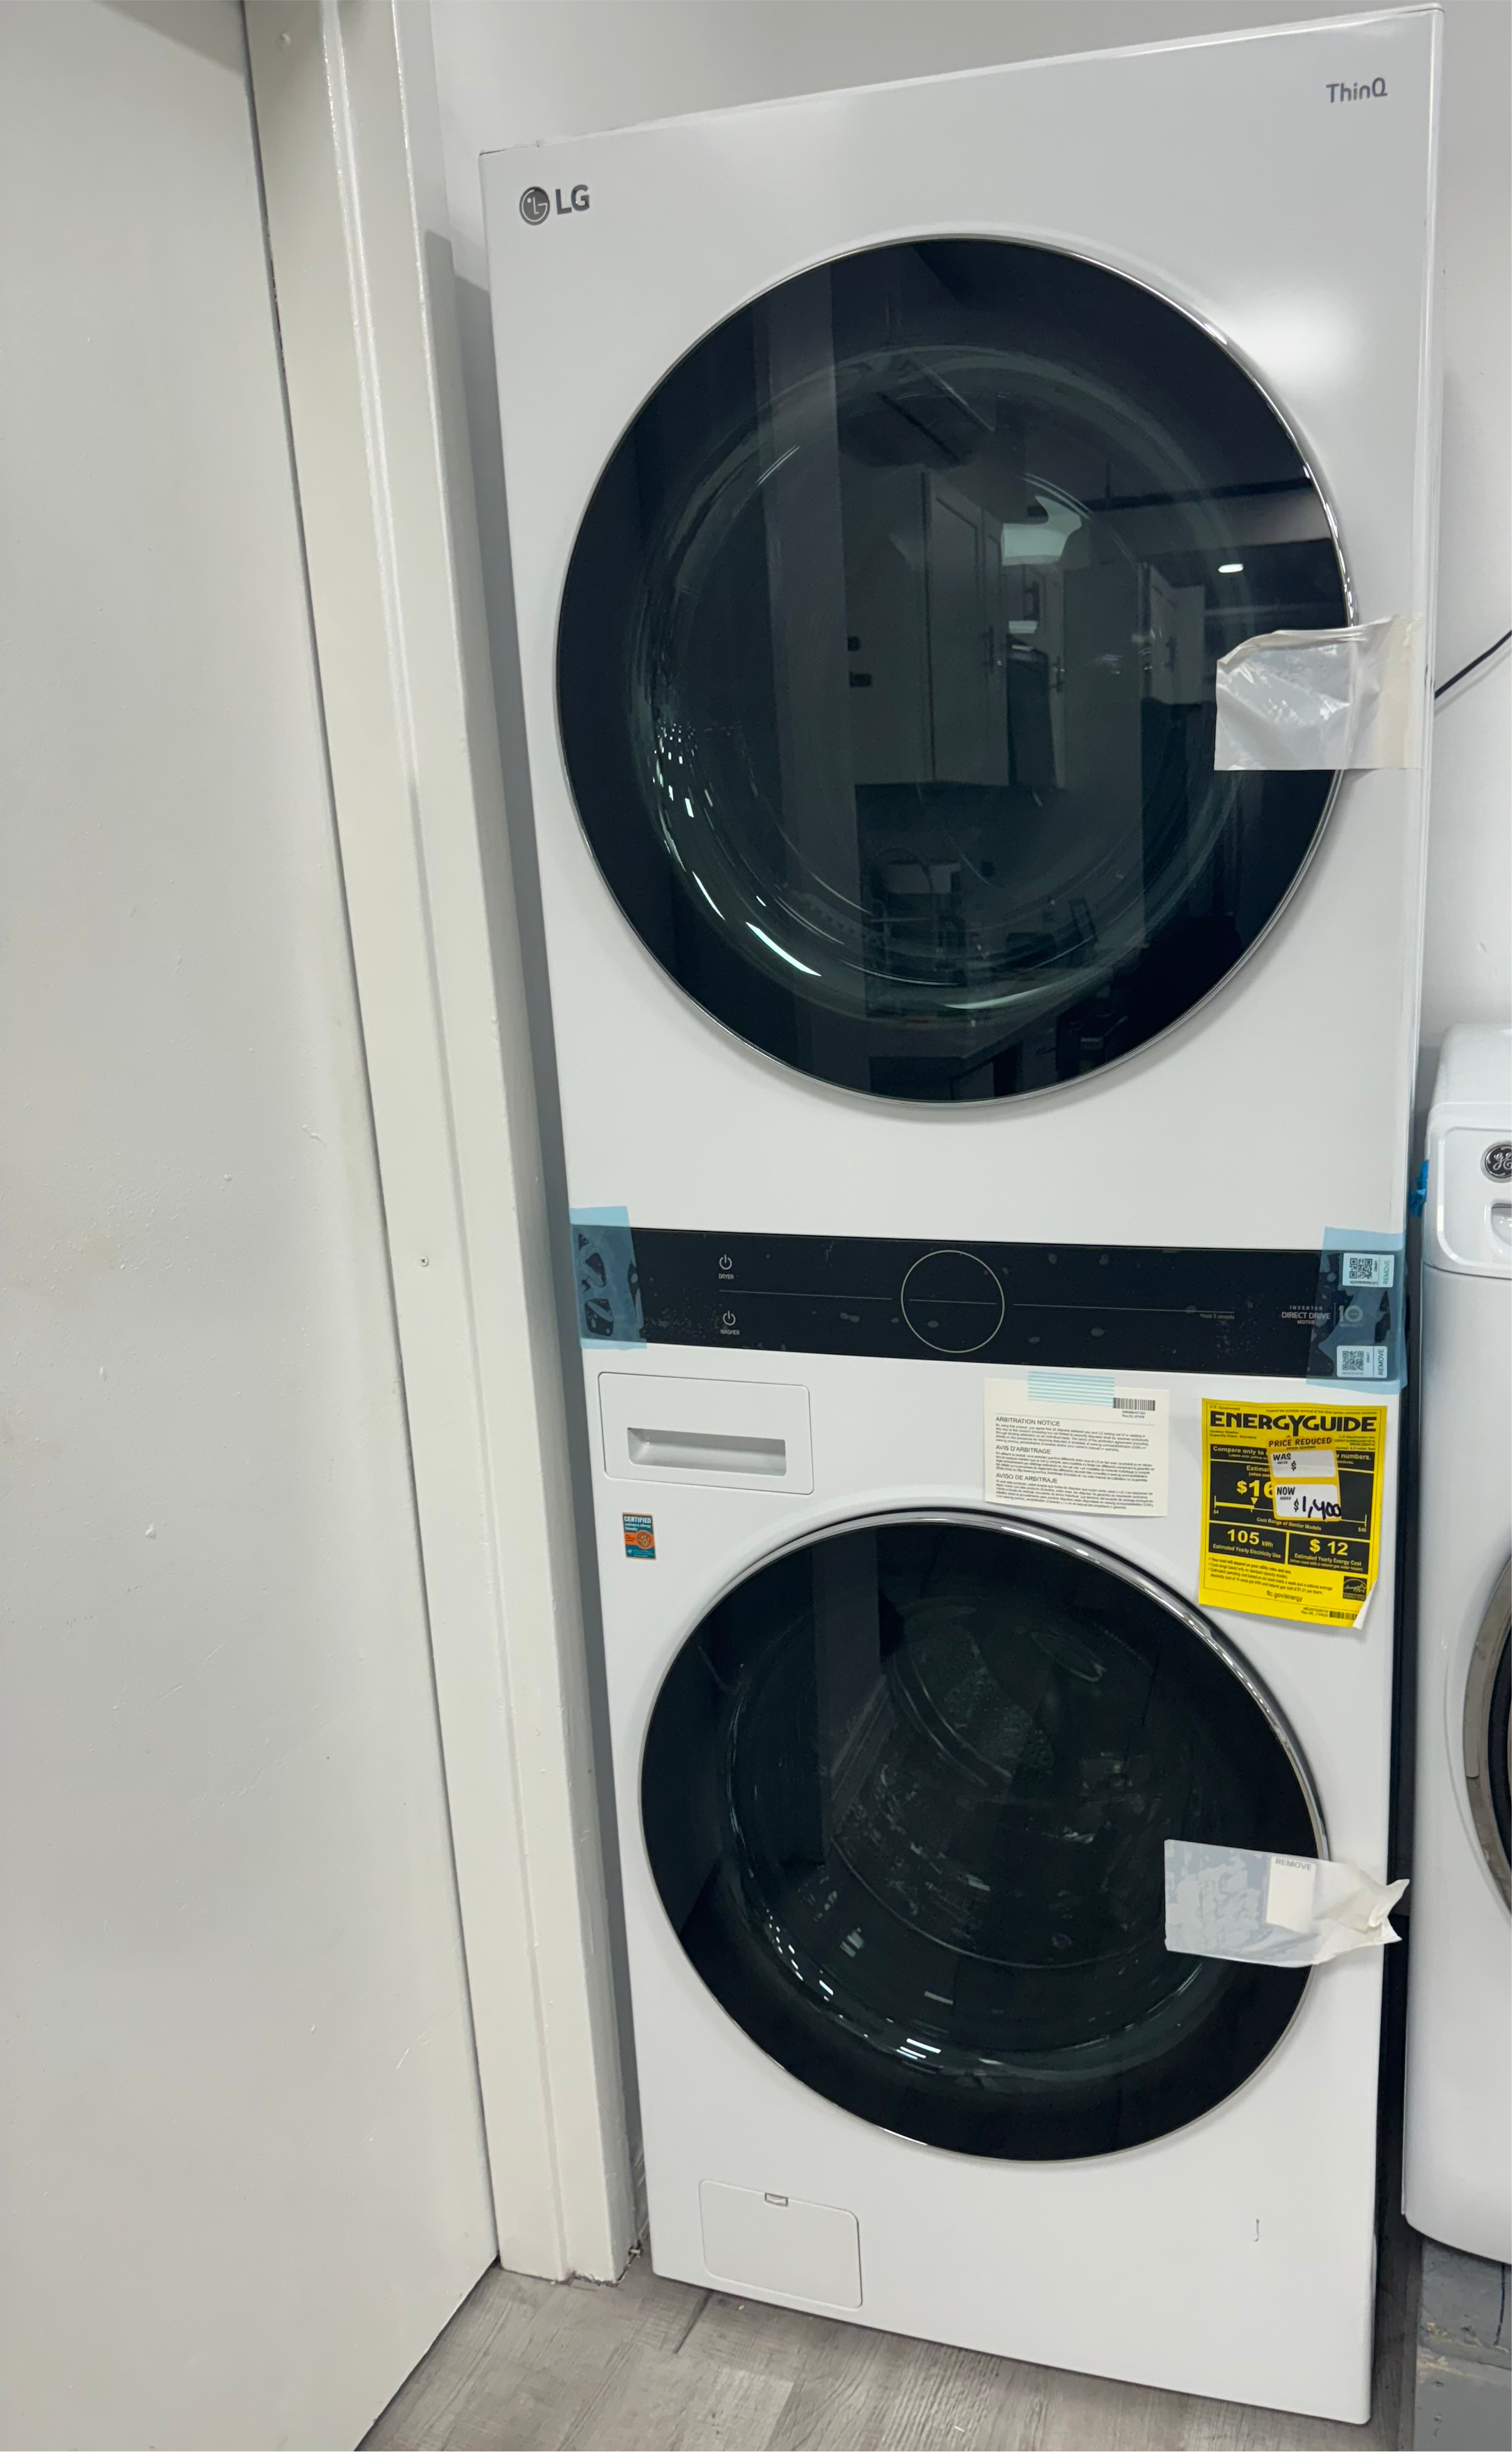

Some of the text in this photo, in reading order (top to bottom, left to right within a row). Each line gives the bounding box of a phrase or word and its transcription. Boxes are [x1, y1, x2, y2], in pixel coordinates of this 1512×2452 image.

[1326, 77, 1388, 103] ThinQ
[556, 184, 590, 215] LG
[995, 1416, 1036, 1425] ARBITRATION
[1210, 1410, 1377, 1436] ENERGYGUIDE
[1295, 1437, 1332, 1446] REDUCED
[1010, 1446, 1051, 1455] D'ARBITRAGE
[1291, 1460, 1297, 1471] $
[1277, 1486, 1295, 1496] NOW
[1227, 1529, 1259, 1545] 105
[1250, 1549, 1272, 1557] Electricity
[1309, 1538, 1348, 1556] $ 12
[1275, 1857, 1312, 1870] REMOVE
